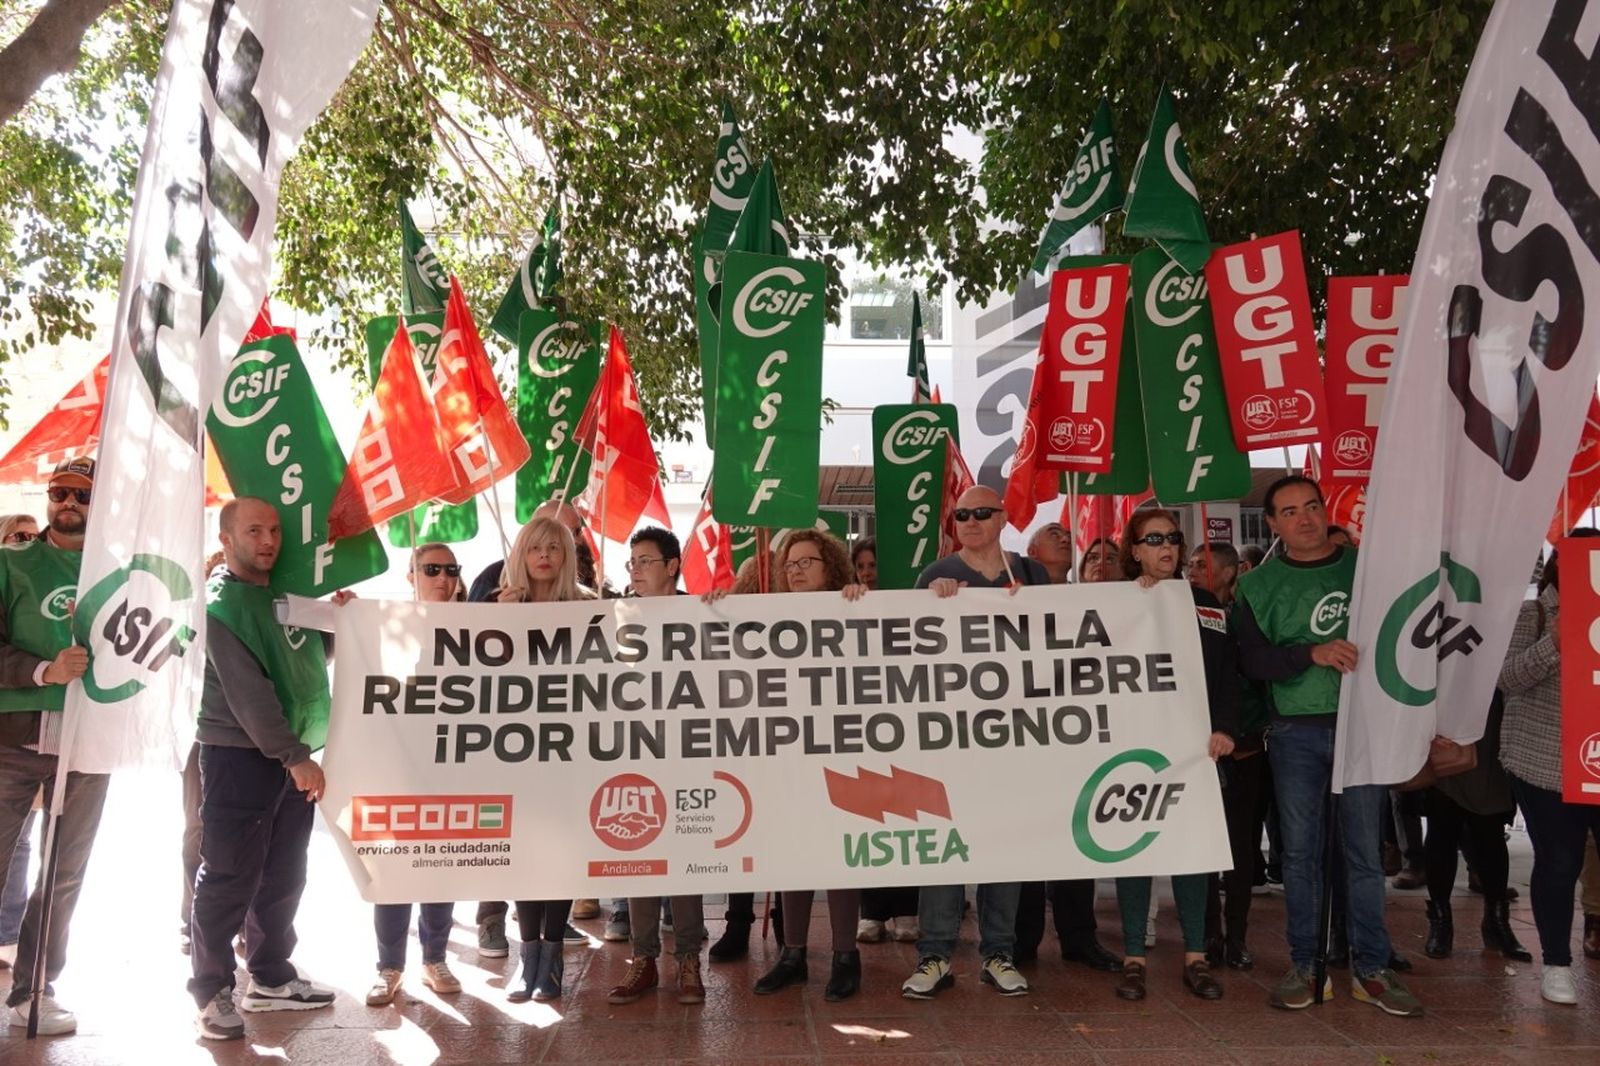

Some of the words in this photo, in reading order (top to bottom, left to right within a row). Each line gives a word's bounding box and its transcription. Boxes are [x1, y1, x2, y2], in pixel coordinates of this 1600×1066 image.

[715, 137, 753, 190] CSI
[749, 286, 815, 316] CSIF
[1224, 244, 1299, 390] UGT
[1059, 275, 1112, 414] UGT
[228, 363, 291, 404] CSIF
[747, 349, 788, 516] CSIF
[895, 426, 949, 446] CSIF
[265, 423, 336, 587] CSIF
[433, 628, 514, 668] NO
[527, 614, 649, 666] MÁS
[661, 616, 948, 663] RECORTES
[959, 614, 1032, 655] EN
[1044, 609, 1113, 651] LA
[362, 668, 706, 715] RESIDENCIA
[717, 668, 788, 710] DE
[798, 660, 1010, 706] TIEMPO
[1021, 653, 1178, 699] LIBRE
[435, 722, 575, 764] ¡POR
[588, 719, 667, 763] UN
[680, 712, 906, 759] EMPLEO
[917, 703, 1112, 751] DIGNO!
[361, 803, 475, 832] CCOO
[598, 785, 657, 818] UGT
[675, 813, 716, 824] Servicios
[1094, 782, 1186, 824] CSIF
[354, 843, 409, 856] ervicios
[413, 845, 421, 855] a
[424, 842, 436, 855] la
[439, 841, 511, 855] ciudadanía
[675, 823, 713, 835] Públicos
[843, 827, 970, 868] USTEA
[412, 856, 454, 868] almería
[456, 855, 511, 867] andalucía
[601, 862, 652, 875] Andalucía
[685, 862, 729, 876] Almería
